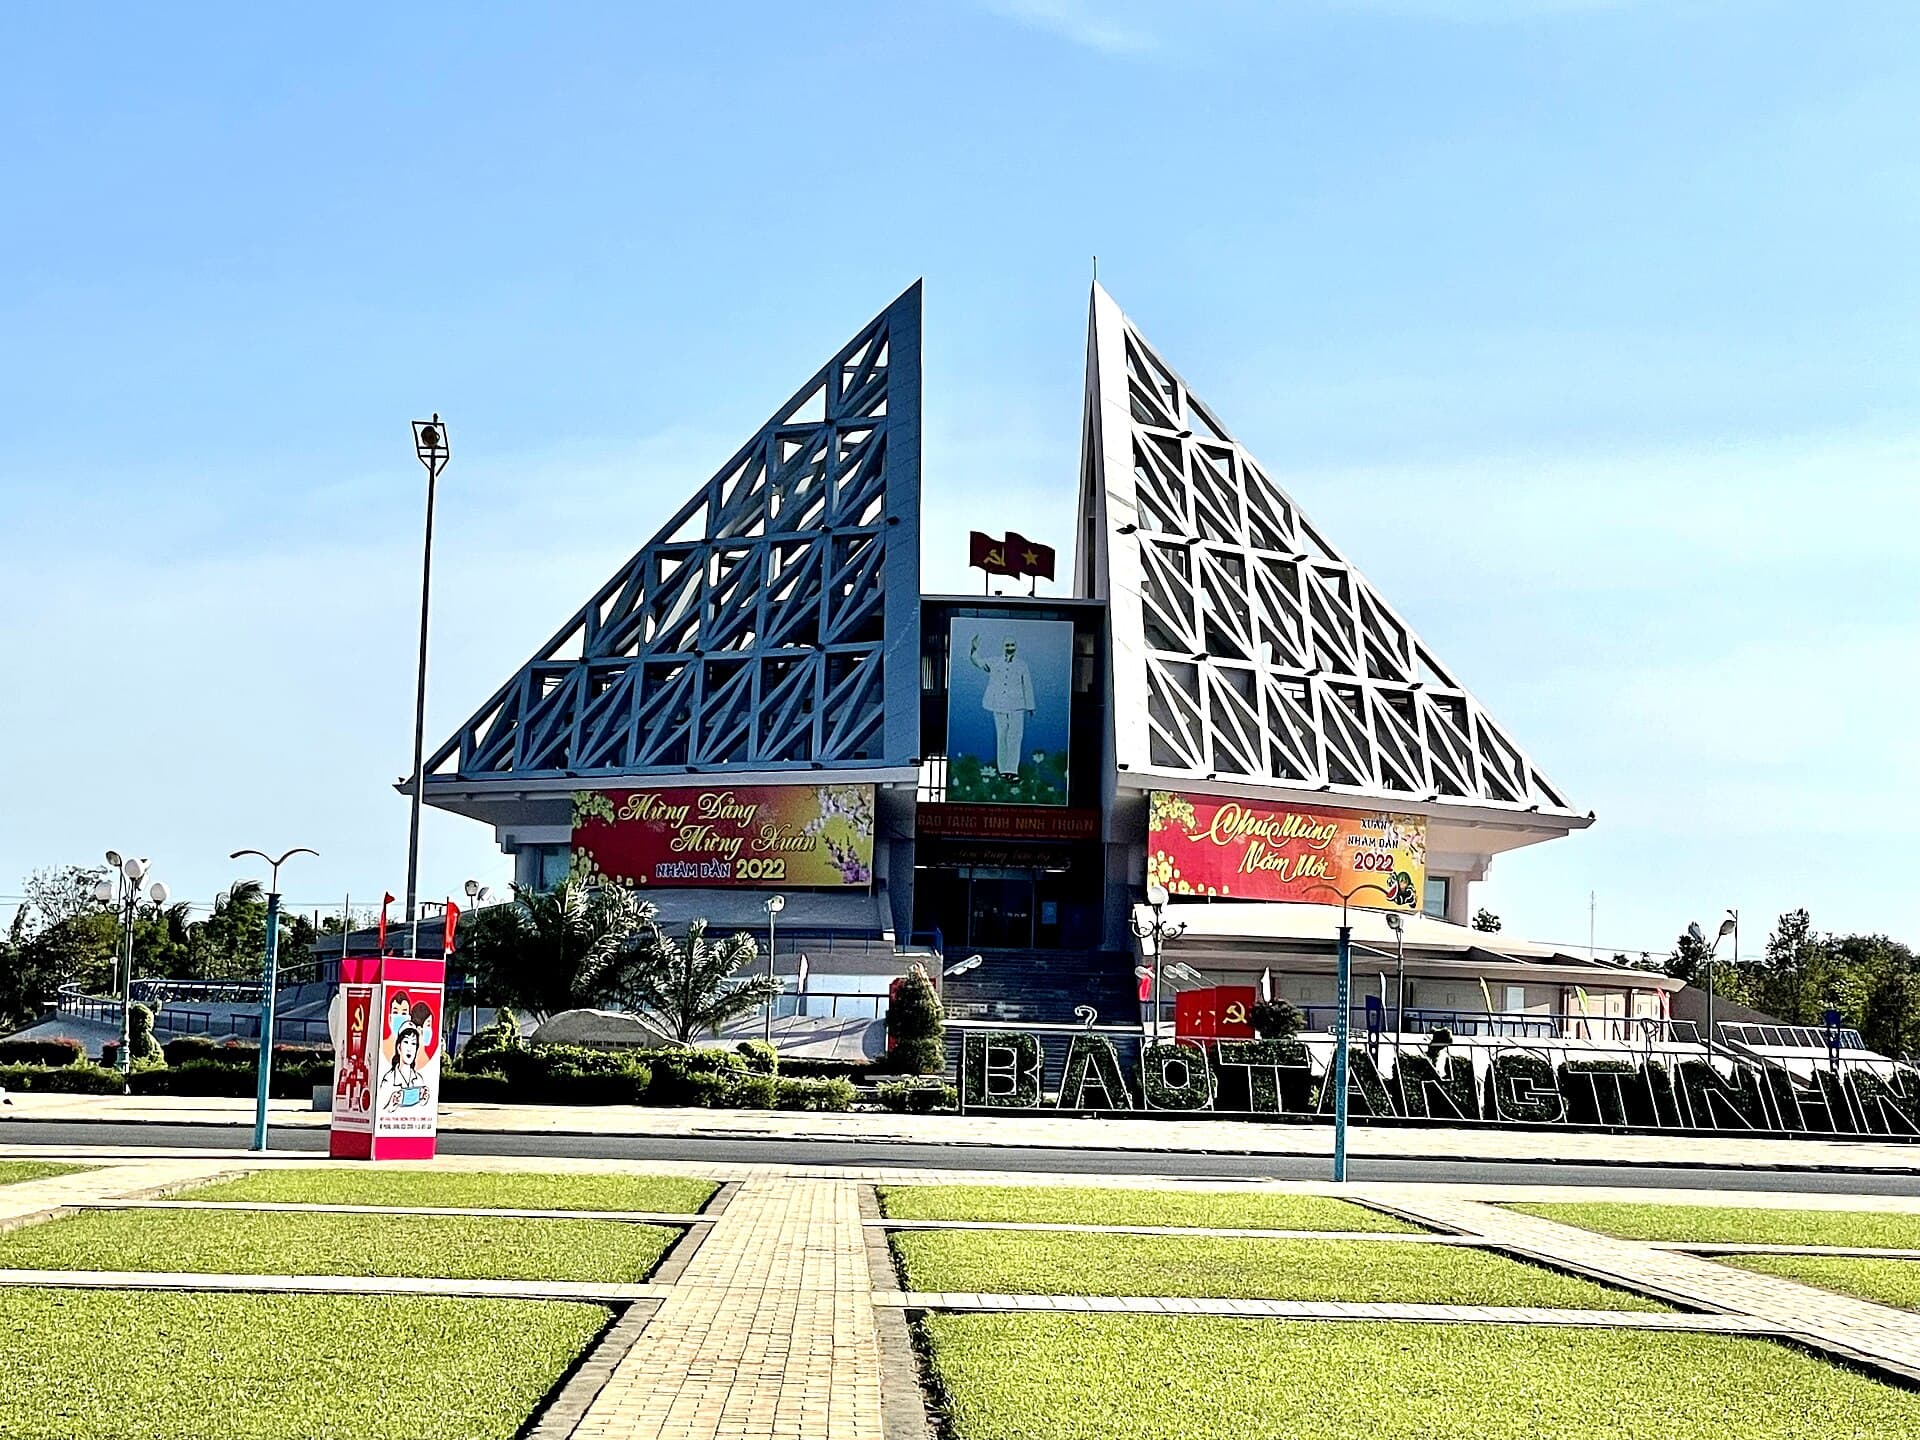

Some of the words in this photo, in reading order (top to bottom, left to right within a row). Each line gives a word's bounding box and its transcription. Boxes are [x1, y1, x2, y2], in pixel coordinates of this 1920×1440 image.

[618, 793, 690, 828] Mừng
[697, 791, 759, 828] Đảng
[1015, 817, 1045, 830] NINH
[1188, 803, 1290, 848] Chúc
[1280, 813, 1338, 849] Mừng
[670, 824, 744, 861] Mừng
[751, 823, 816, 852] Xuân
[735, 858, 785, 879] 2022
[1237, 840, 1296, 882] Năm
[1293, 853, 1337, 879] Mới
[1354, 852, 1394, 872] 2022
